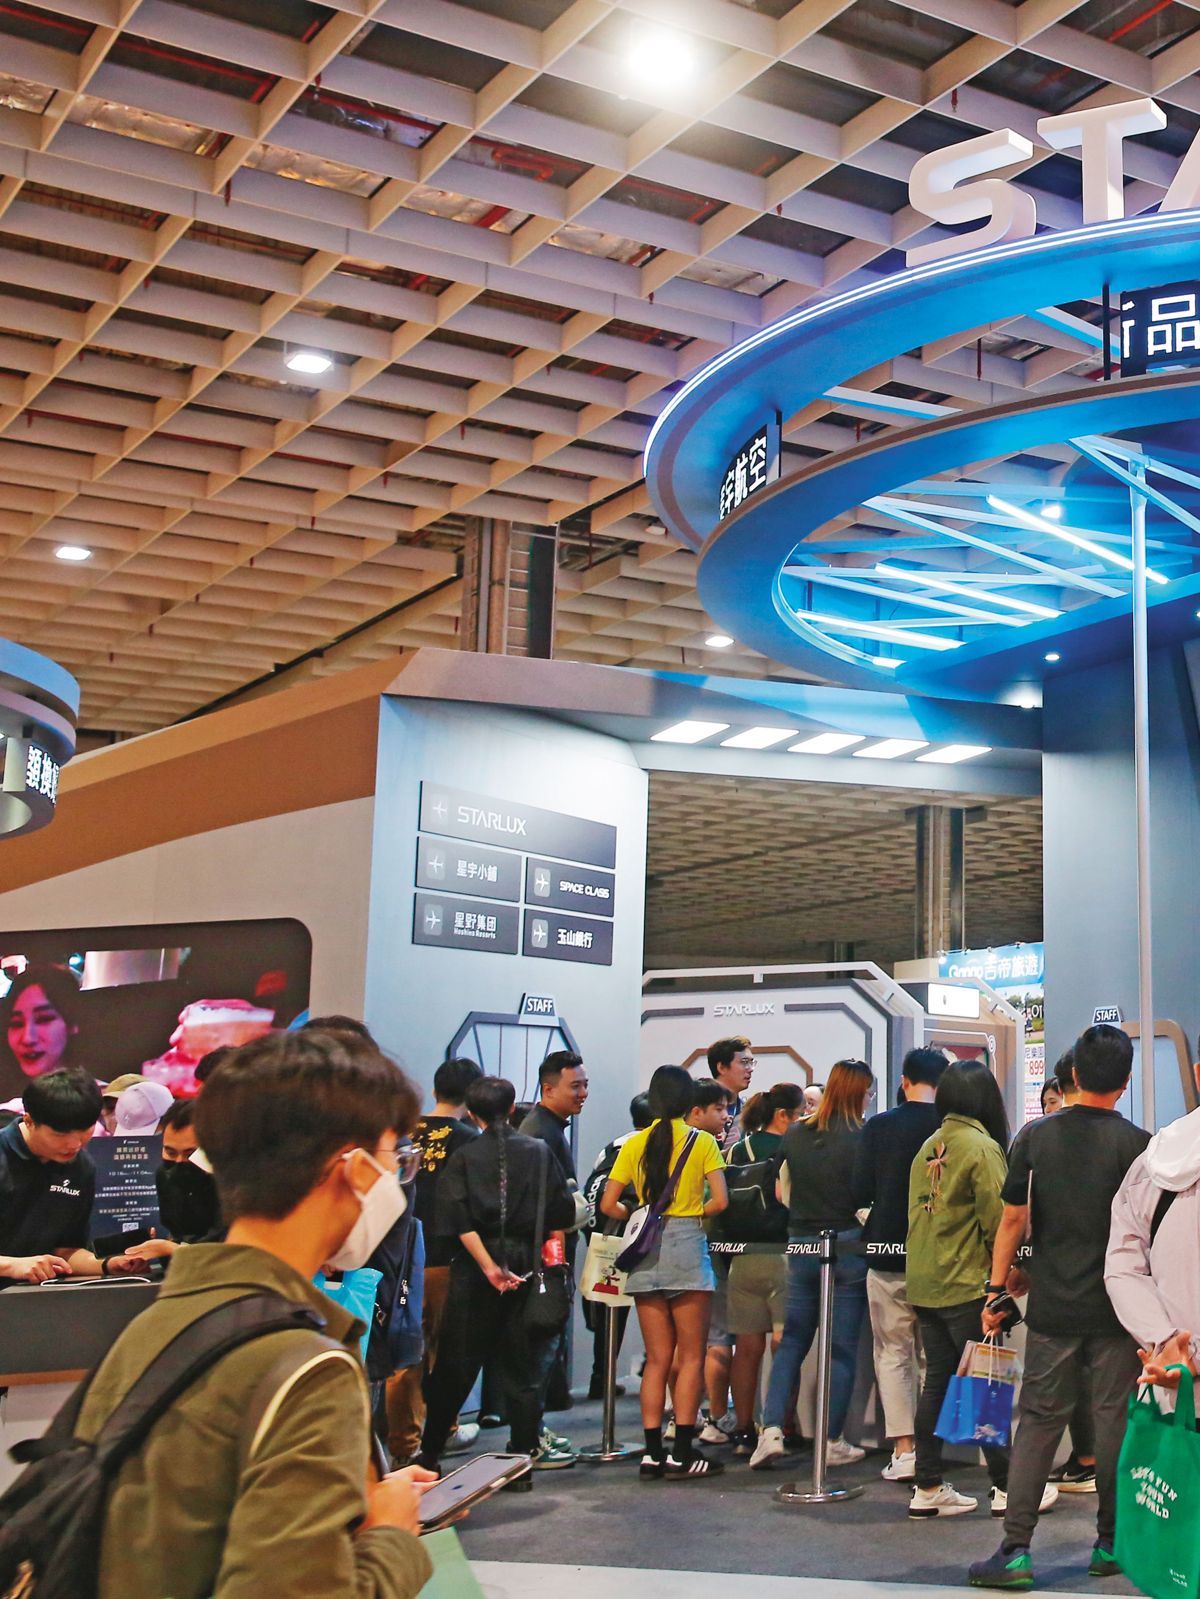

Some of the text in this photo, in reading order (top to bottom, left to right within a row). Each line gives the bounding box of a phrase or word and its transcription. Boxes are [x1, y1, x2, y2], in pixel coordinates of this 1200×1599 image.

[457, 806, 527, 836] STARLUX
[559, 880, 610, 899] SPACE CLASS
[526, 998, 553, 1013] STAFF
[713, 1002, 775, 1017] STARLUX
[1096, 1009, 1117, 1021] STAFF
[50, 1184, 80, 1196] STARLUX
[708, 1242, 747, 1253] STARLUX
[785, 1243, 821, 1254] STARLU
[1155, 1476, 1178, 1501] FUN
[1135, 1492, 1169, 1519] WORLD
